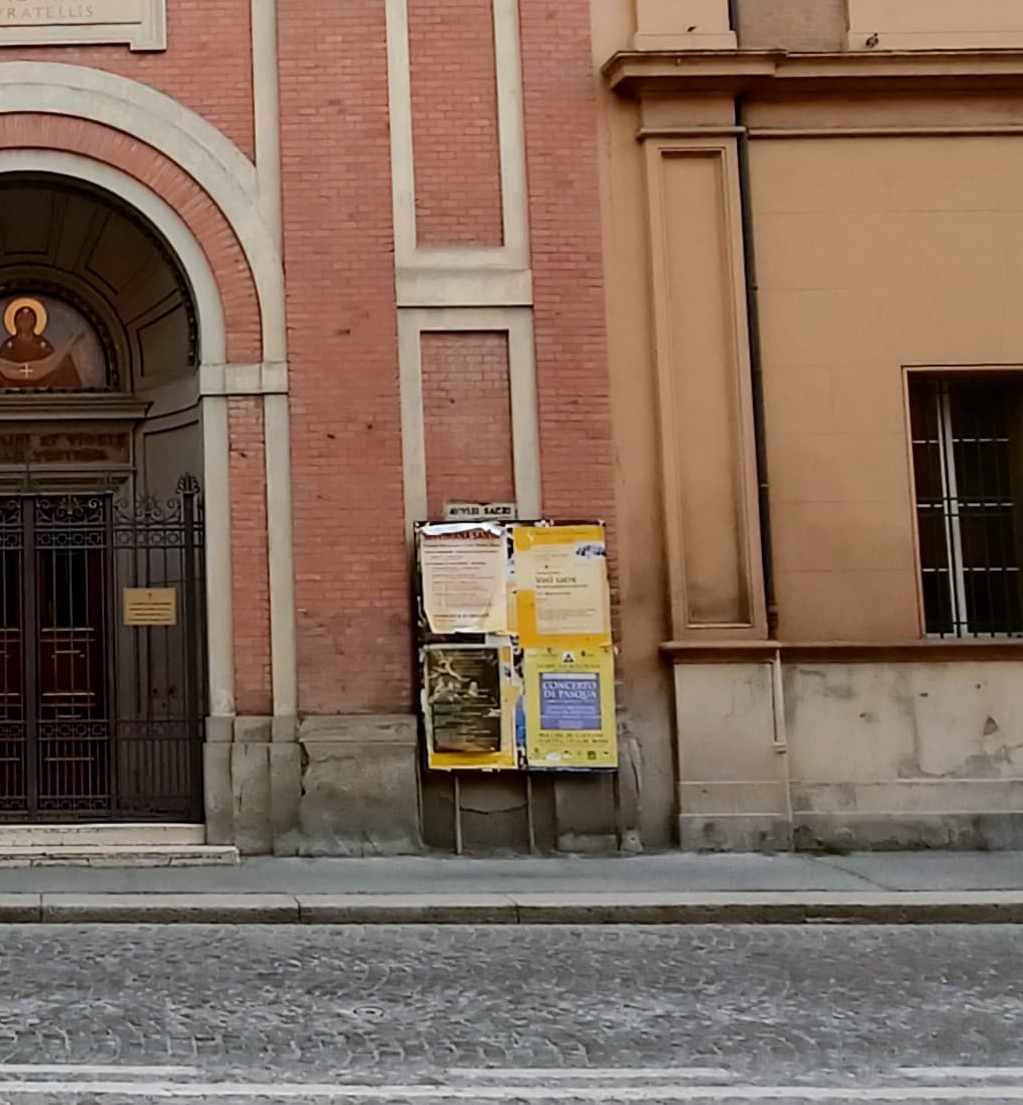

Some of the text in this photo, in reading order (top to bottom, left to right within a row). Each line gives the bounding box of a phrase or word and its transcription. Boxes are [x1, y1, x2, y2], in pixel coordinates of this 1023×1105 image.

[542, 681, 597, 690] CONCERTO
[543, 690, 597, 699] DI PASQUA
